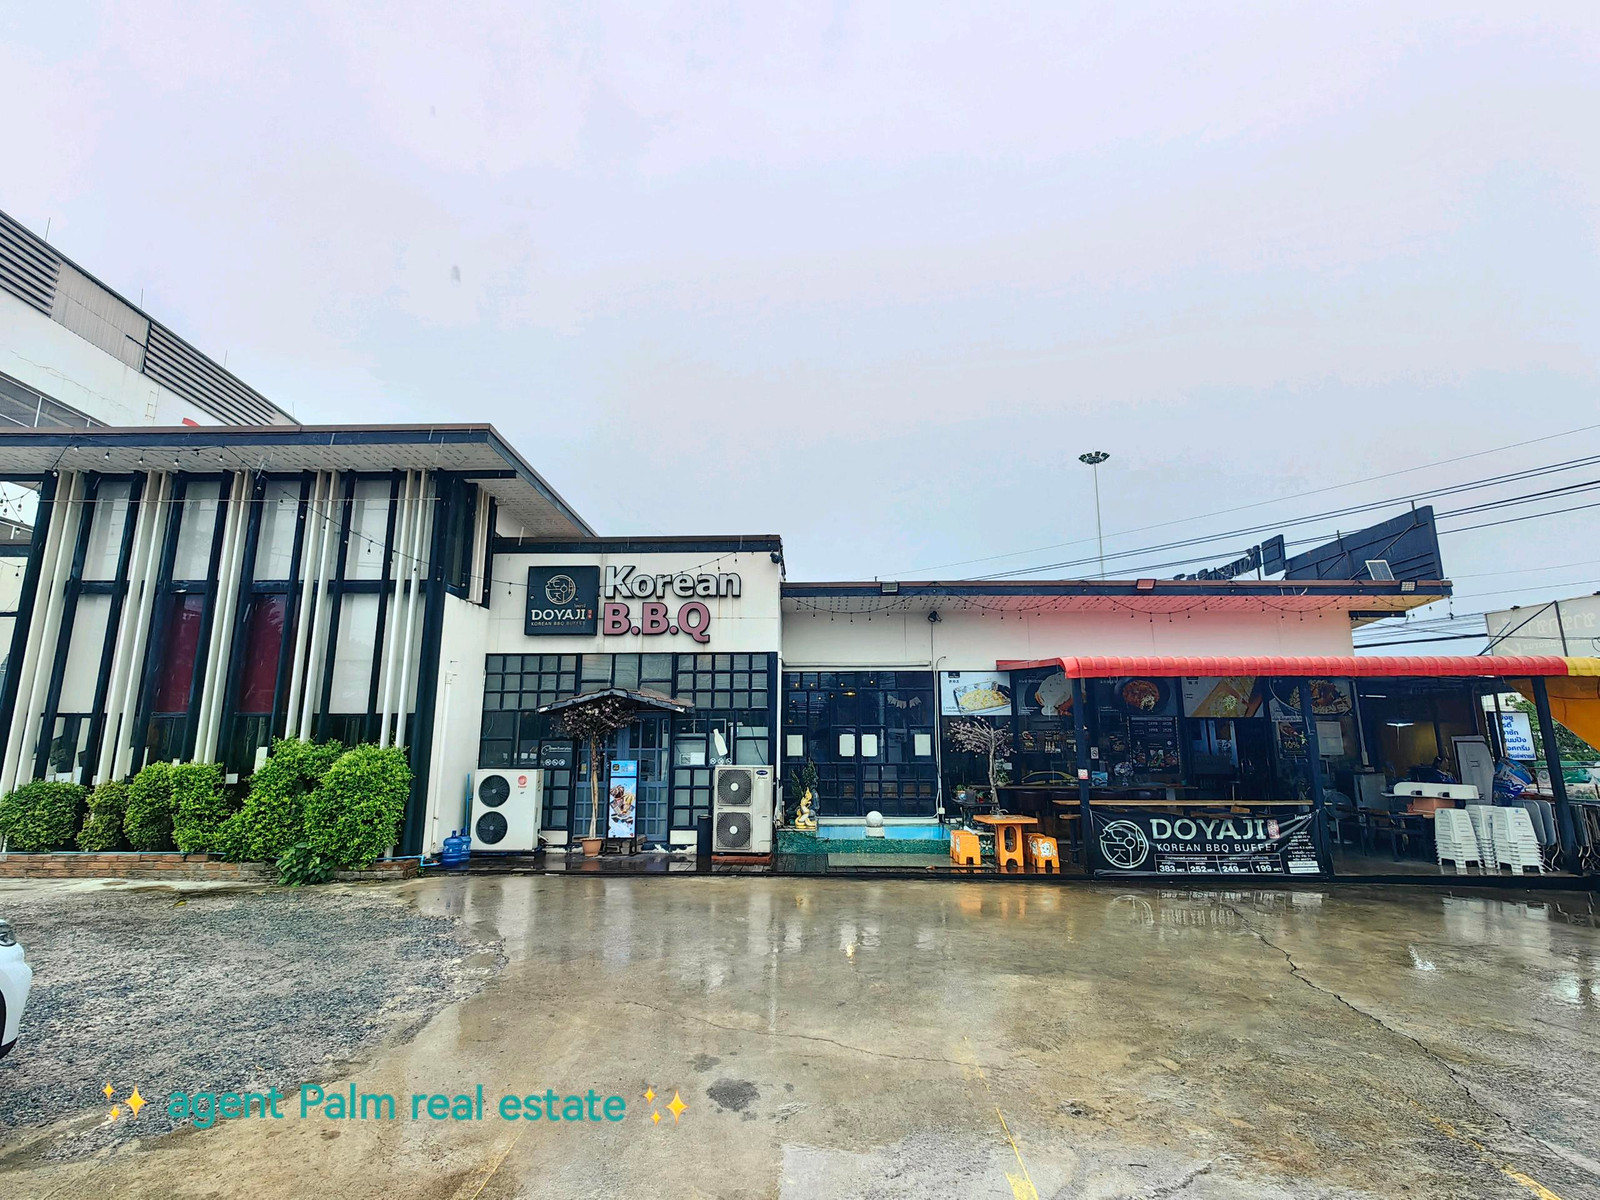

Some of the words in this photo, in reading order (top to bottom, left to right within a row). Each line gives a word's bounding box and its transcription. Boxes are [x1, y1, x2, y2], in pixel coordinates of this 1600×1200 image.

[604, 565, 742, 599] Korean
[531, 609, 586, 620] DOYAJI
[602, 601, 711, 643] B.B.Q
[1149, 818, 1267, 840] DOYAJI
[1156, 843, 1201, 852] KOREAN
[1205, 843, 1230, 853] BBQ
[1234, 843, 1279, 852] BUFFET
